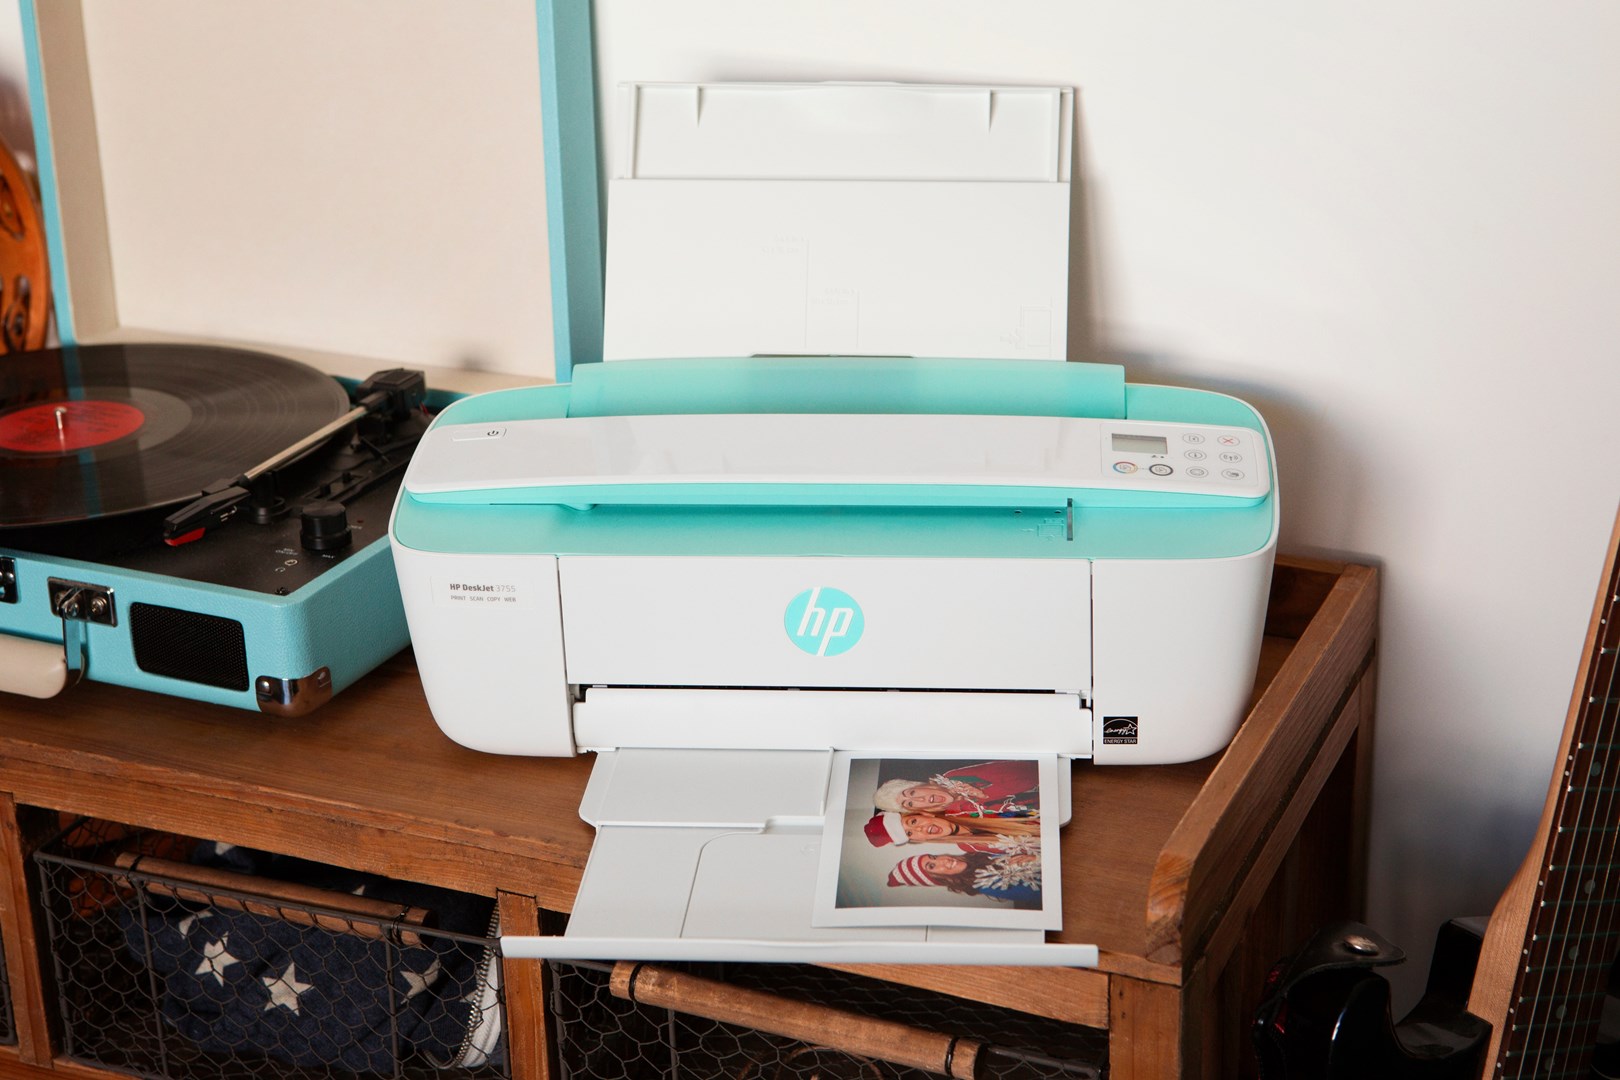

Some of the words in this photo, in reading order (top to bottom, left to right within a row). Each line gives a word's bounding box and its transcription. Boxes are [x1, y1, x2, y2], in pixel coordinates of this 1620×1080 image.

[462, 584, 494, 592] DeskJet
[495, 584, 516, 593] 3755
[796, 586, 854, 657] hp
